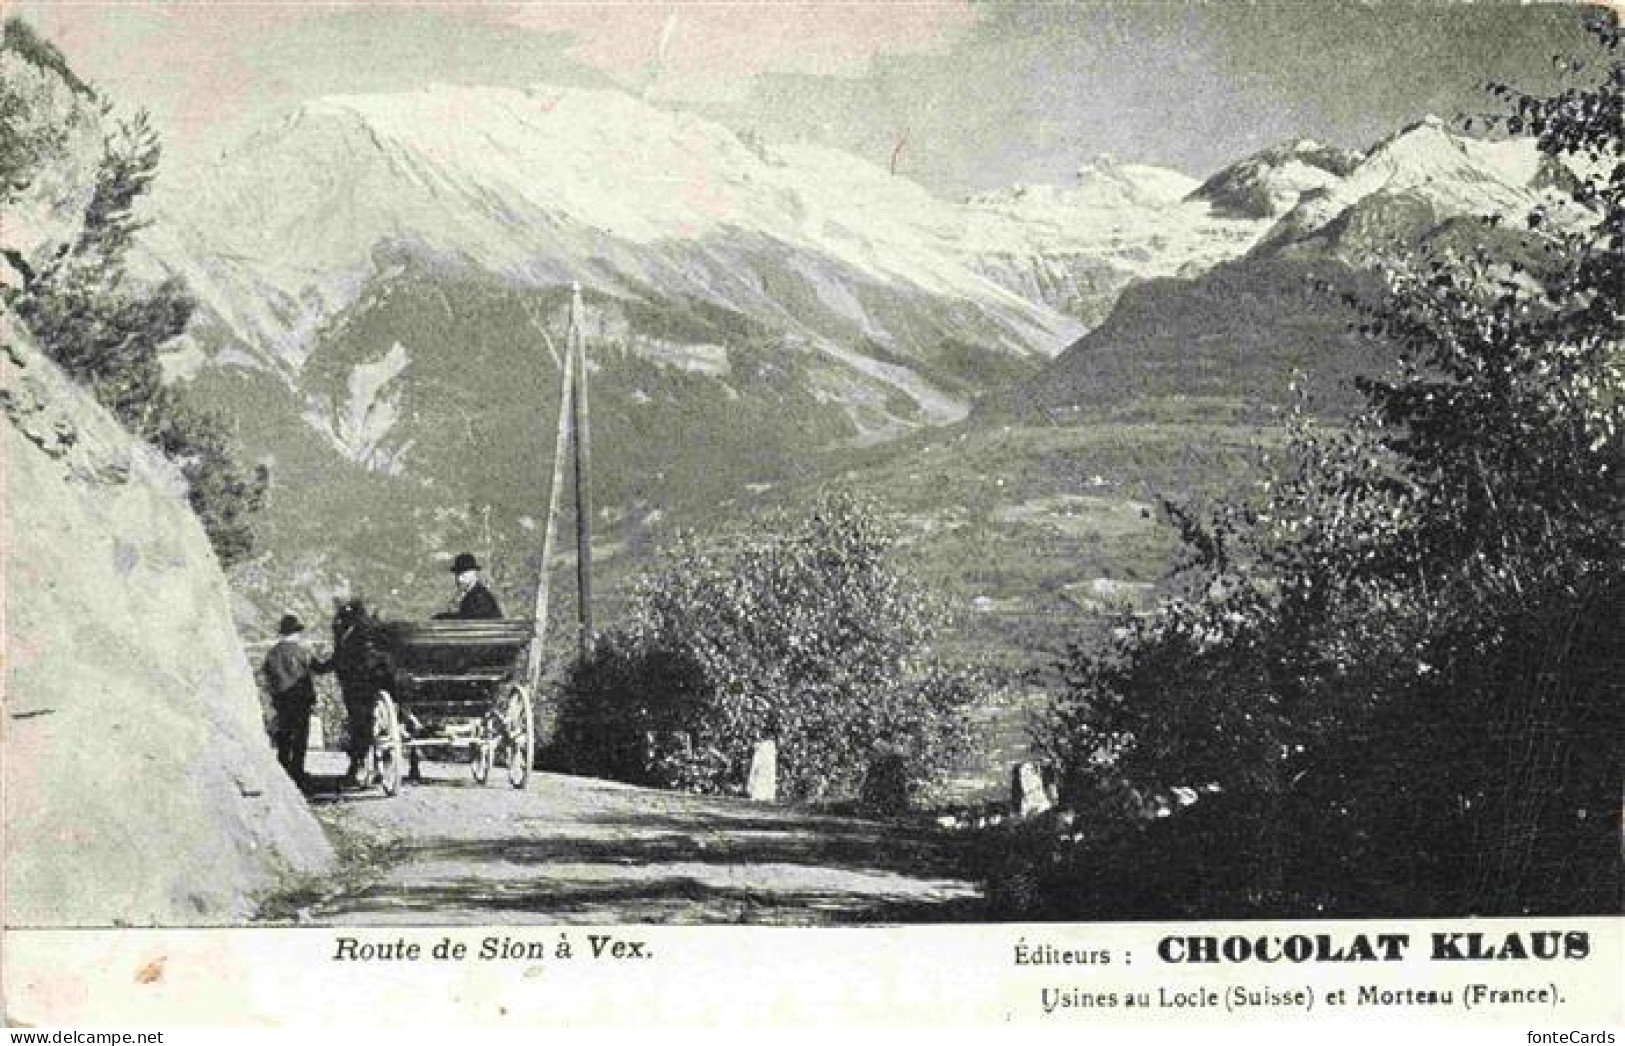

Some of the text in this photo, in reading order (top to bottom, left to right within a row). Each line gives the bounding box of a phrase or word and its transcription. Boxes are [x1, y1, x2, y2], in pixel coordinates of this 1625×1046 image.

[333, 932, 654, 961] Route de Sion à Vex.
[1014, 936, 1112, 966] Éditeurs
[1156, 934, 1411, 964] CHOCOLAT
[1430, 930, 1591, 961] KLAUS
[1041, 982, 1567, 1013] Usines au Locle (Suisse) et Morteau (France).
